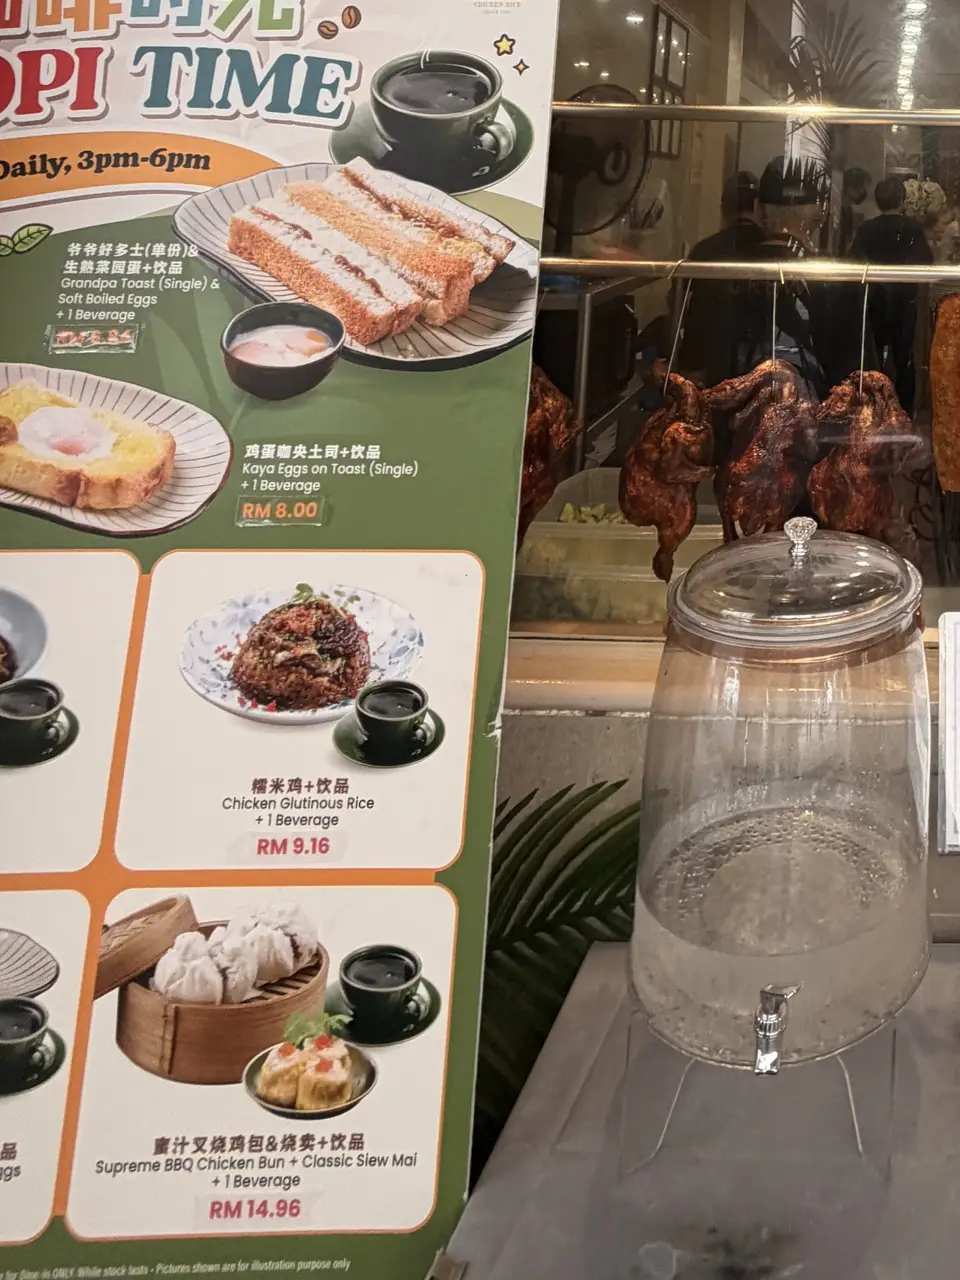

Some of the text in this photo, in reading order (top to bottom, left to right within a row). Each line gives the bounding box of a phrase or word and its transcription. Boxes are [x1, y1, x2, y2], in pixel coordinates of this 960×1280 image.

[0, 46, 353, 120] PI TIME
[77, 147, 211, 173] 3pm-6pm
[61, 276, 220, 292] Grandpa Toast (Single) &
[58, 293, 158, 308] Soft Boiled Eggs
[75, 310, 136, 323] Beverage
[242, 460, 419, 478] Kaya Eggs on Toast (Single)
[260, 480, 321, 494] Beverage
[242, 502, 318, 519] RM 8.00
[222, 796, 375, 810] Chicken Glutinous Rice
[275, 814, 340, 829] Beverage
[256, 837, 330, 855] RM 9.16
[95, 1160, 161, 1178] Supreme
[164, 1157, 194, 1173] BBQ
[197, 1156, 255, 1170] Chicken
[258, 1156, 285, 1169] Bun
[302, 1154, 353, 1168] Classic
[356, 1153, 389, 1167] Siew
[392, 1152, 418, 1167] Mai
[233, 1175, 301, 1191] Beverage
[209, 1199, 301, 1220] RM 14.96
[155, 1263, 191, 1275] Pictures
[192, 1262, 220, 1273] shown
[221, 1263, 236, 1273] are
[237, 1260, 249, 1272] for
[251, 1259, 296, 1271] illustration
[297, 1260, 331, 1273] purpose
[332, 1258, 351, 1272] only
